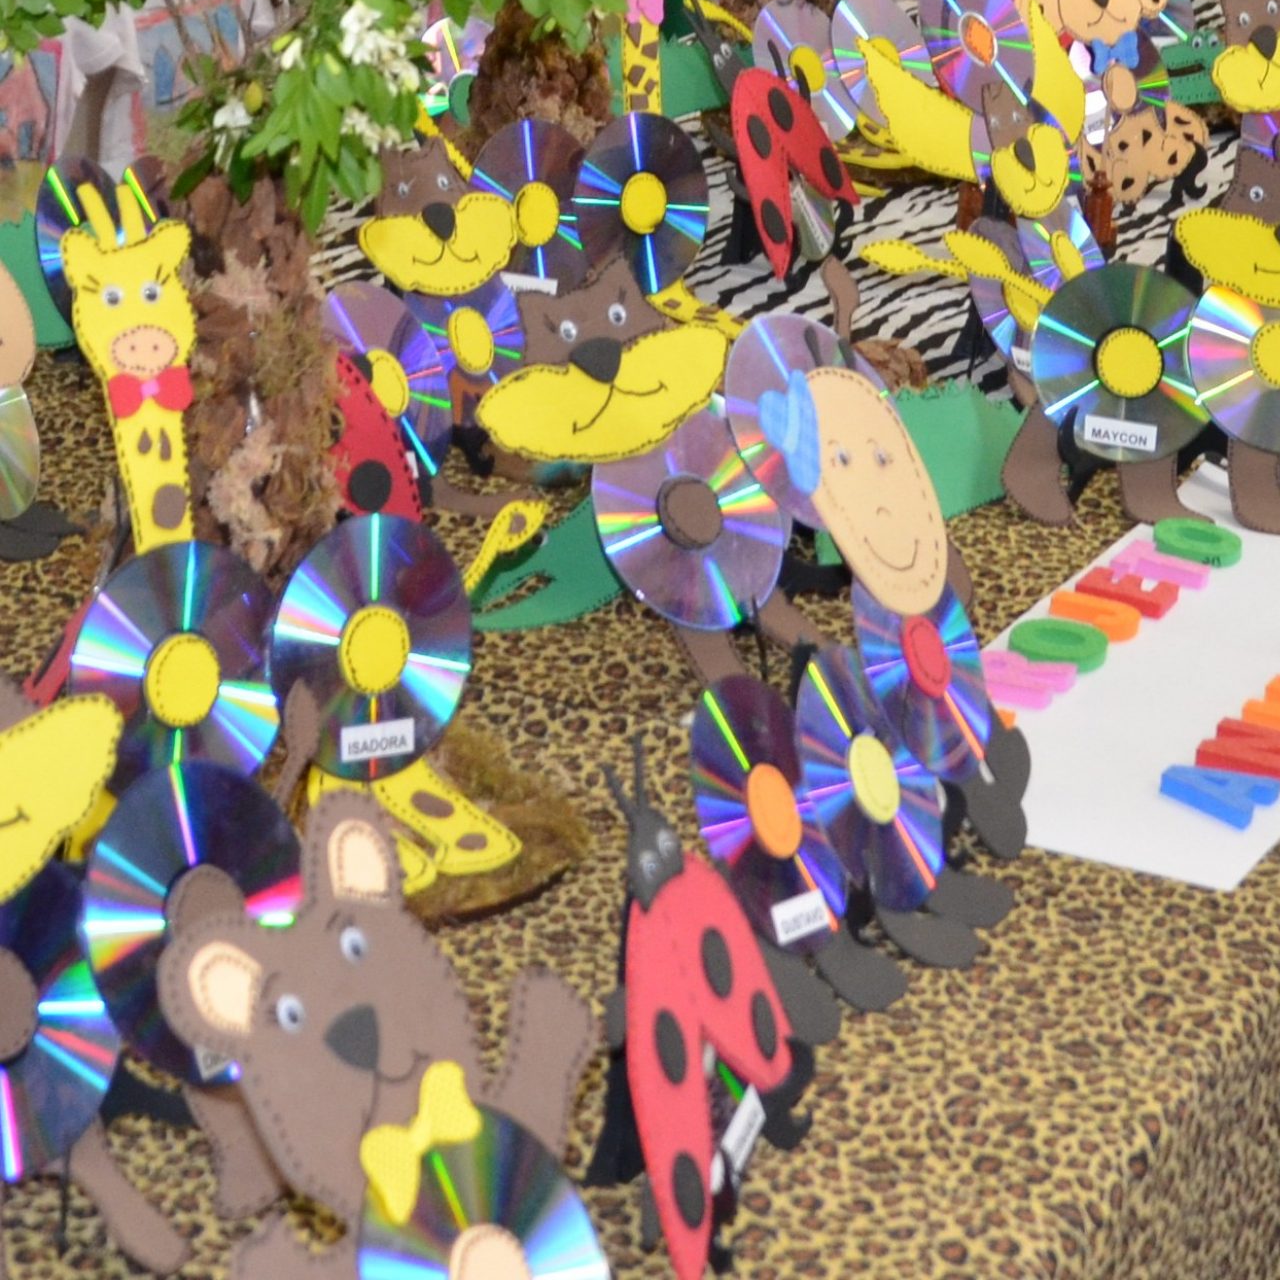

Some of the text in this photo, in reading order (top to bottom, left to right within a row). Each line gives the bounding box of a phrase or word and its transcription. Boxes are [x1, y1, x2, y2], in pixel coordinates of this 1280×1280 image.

[1091, 427, 1147, 447] MAYCON
[980, 517, 1243, 730] ROJETO
[348, 735, 407, 755] ISADORA
